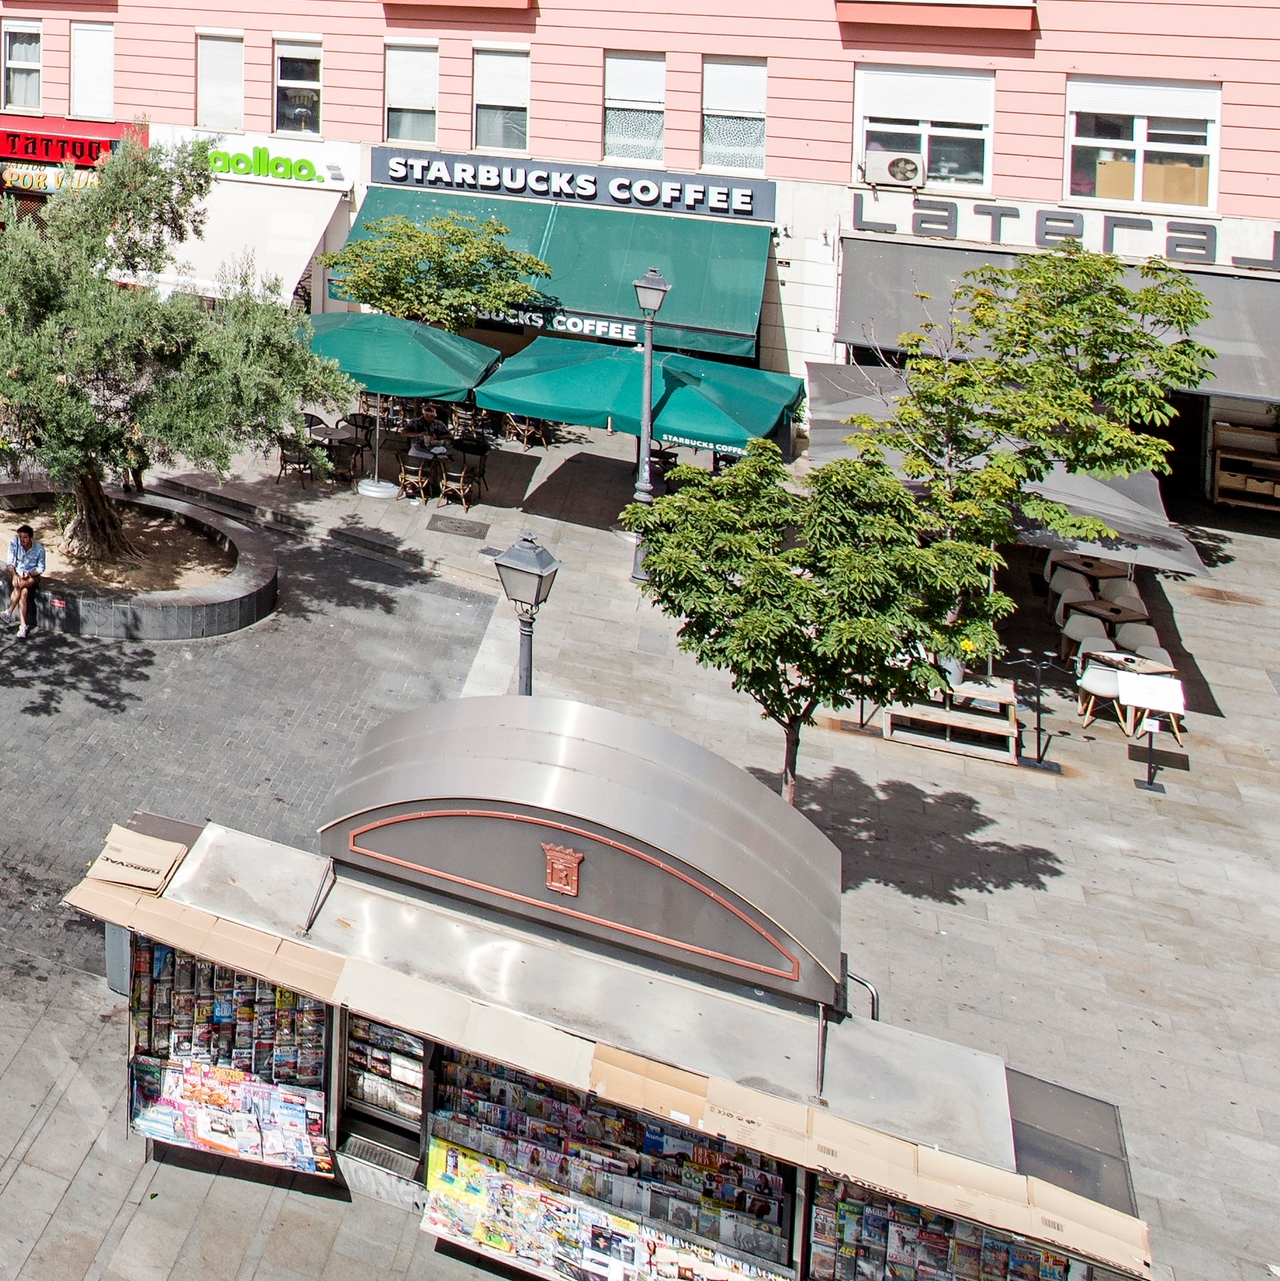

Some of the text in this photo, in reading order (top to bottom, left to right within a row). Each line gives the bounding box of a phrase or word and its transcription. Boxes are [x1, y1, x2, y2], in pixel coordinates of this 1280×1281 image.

[2, 168, 48, 190] POR
[388, 156, 754, 216] STARBUCKS COFFEE
[553, 315, 637, 340] COFFEE
[662, 434, 748, 456] STARBUCKS COFFEE
[100, 855, 162, 875] TURBOVAC
